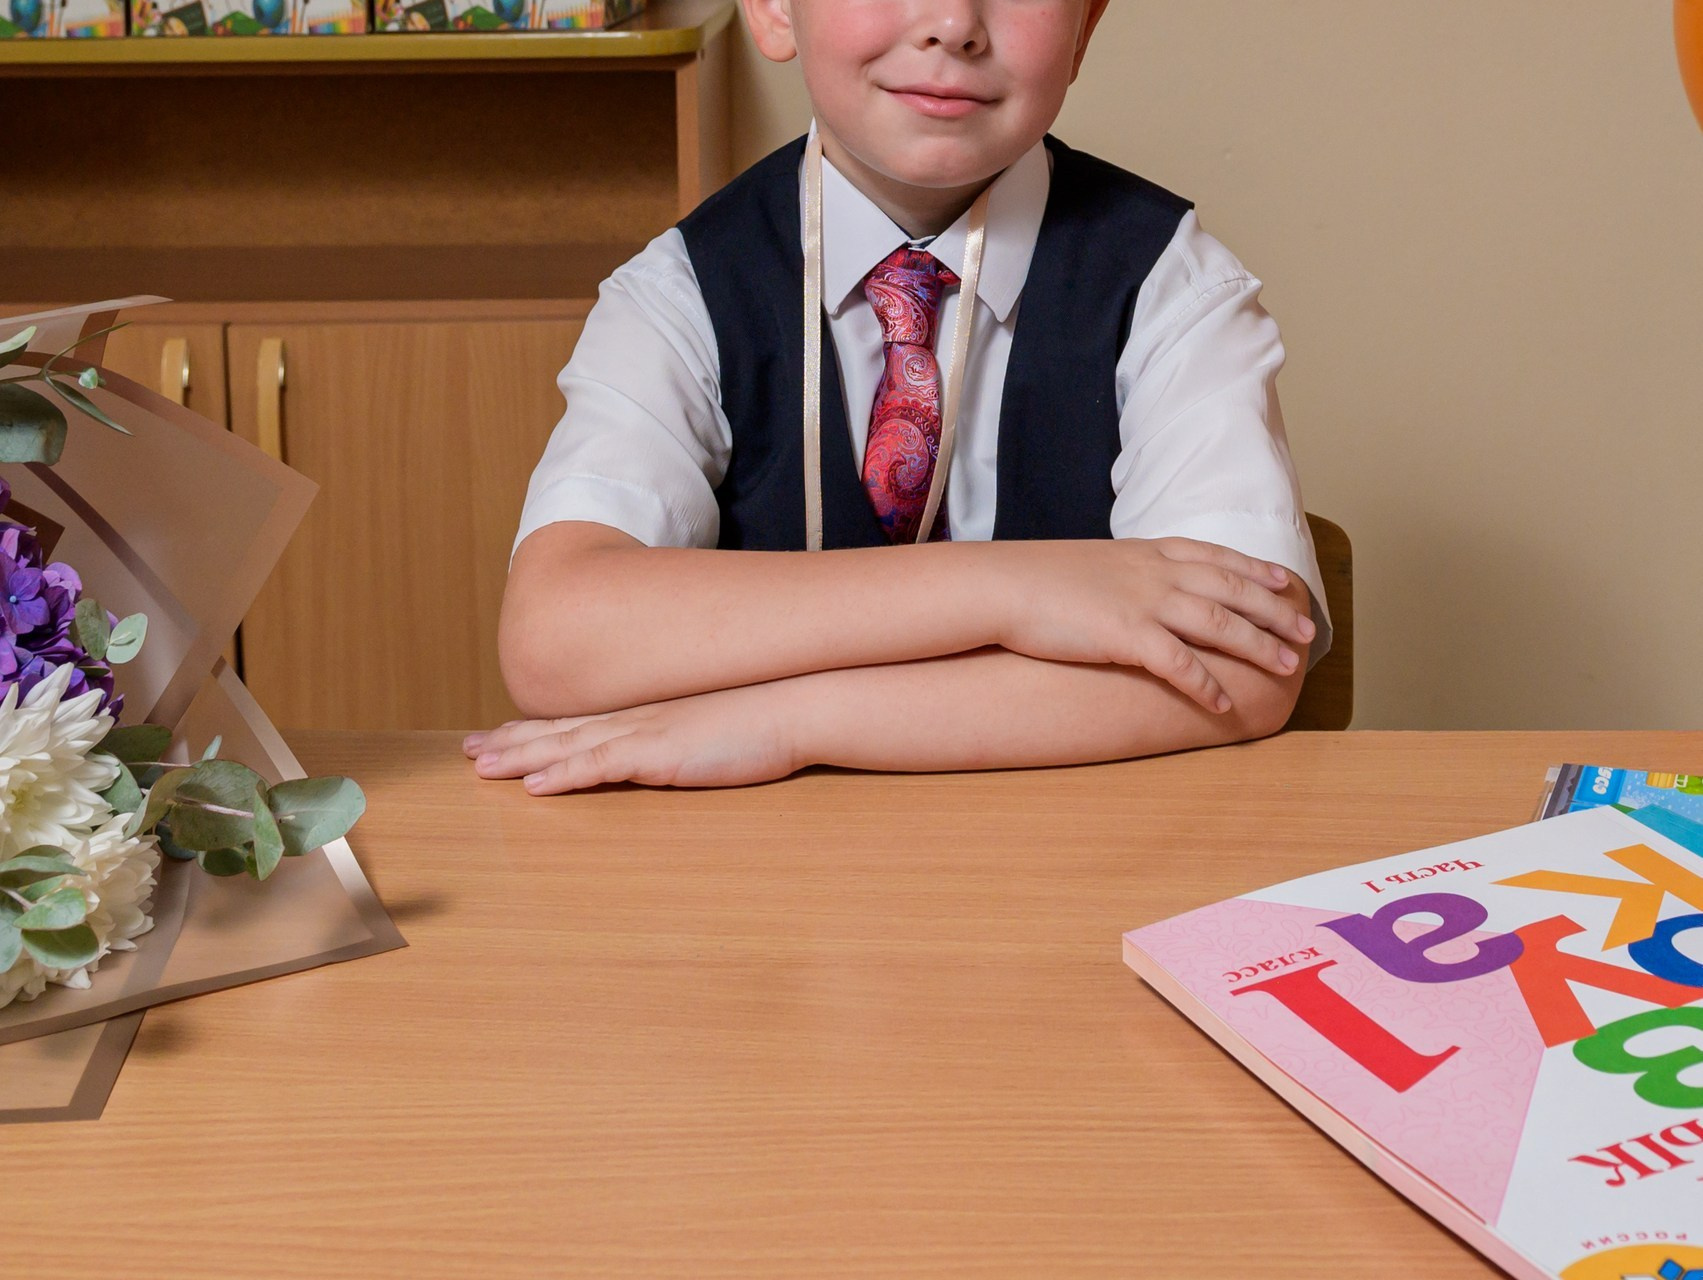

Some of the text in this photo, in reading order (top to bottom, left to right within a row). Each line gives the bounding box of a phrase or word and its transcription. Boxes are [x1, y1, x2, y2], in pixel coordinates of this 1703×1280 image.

[1384, 858, 1485, 886] Часть
[1222, 946, 1324, 984] класс
[1229, 959, 1462, 1094] 1
[1581, 1230, 1687, 1251] РОССИИ
